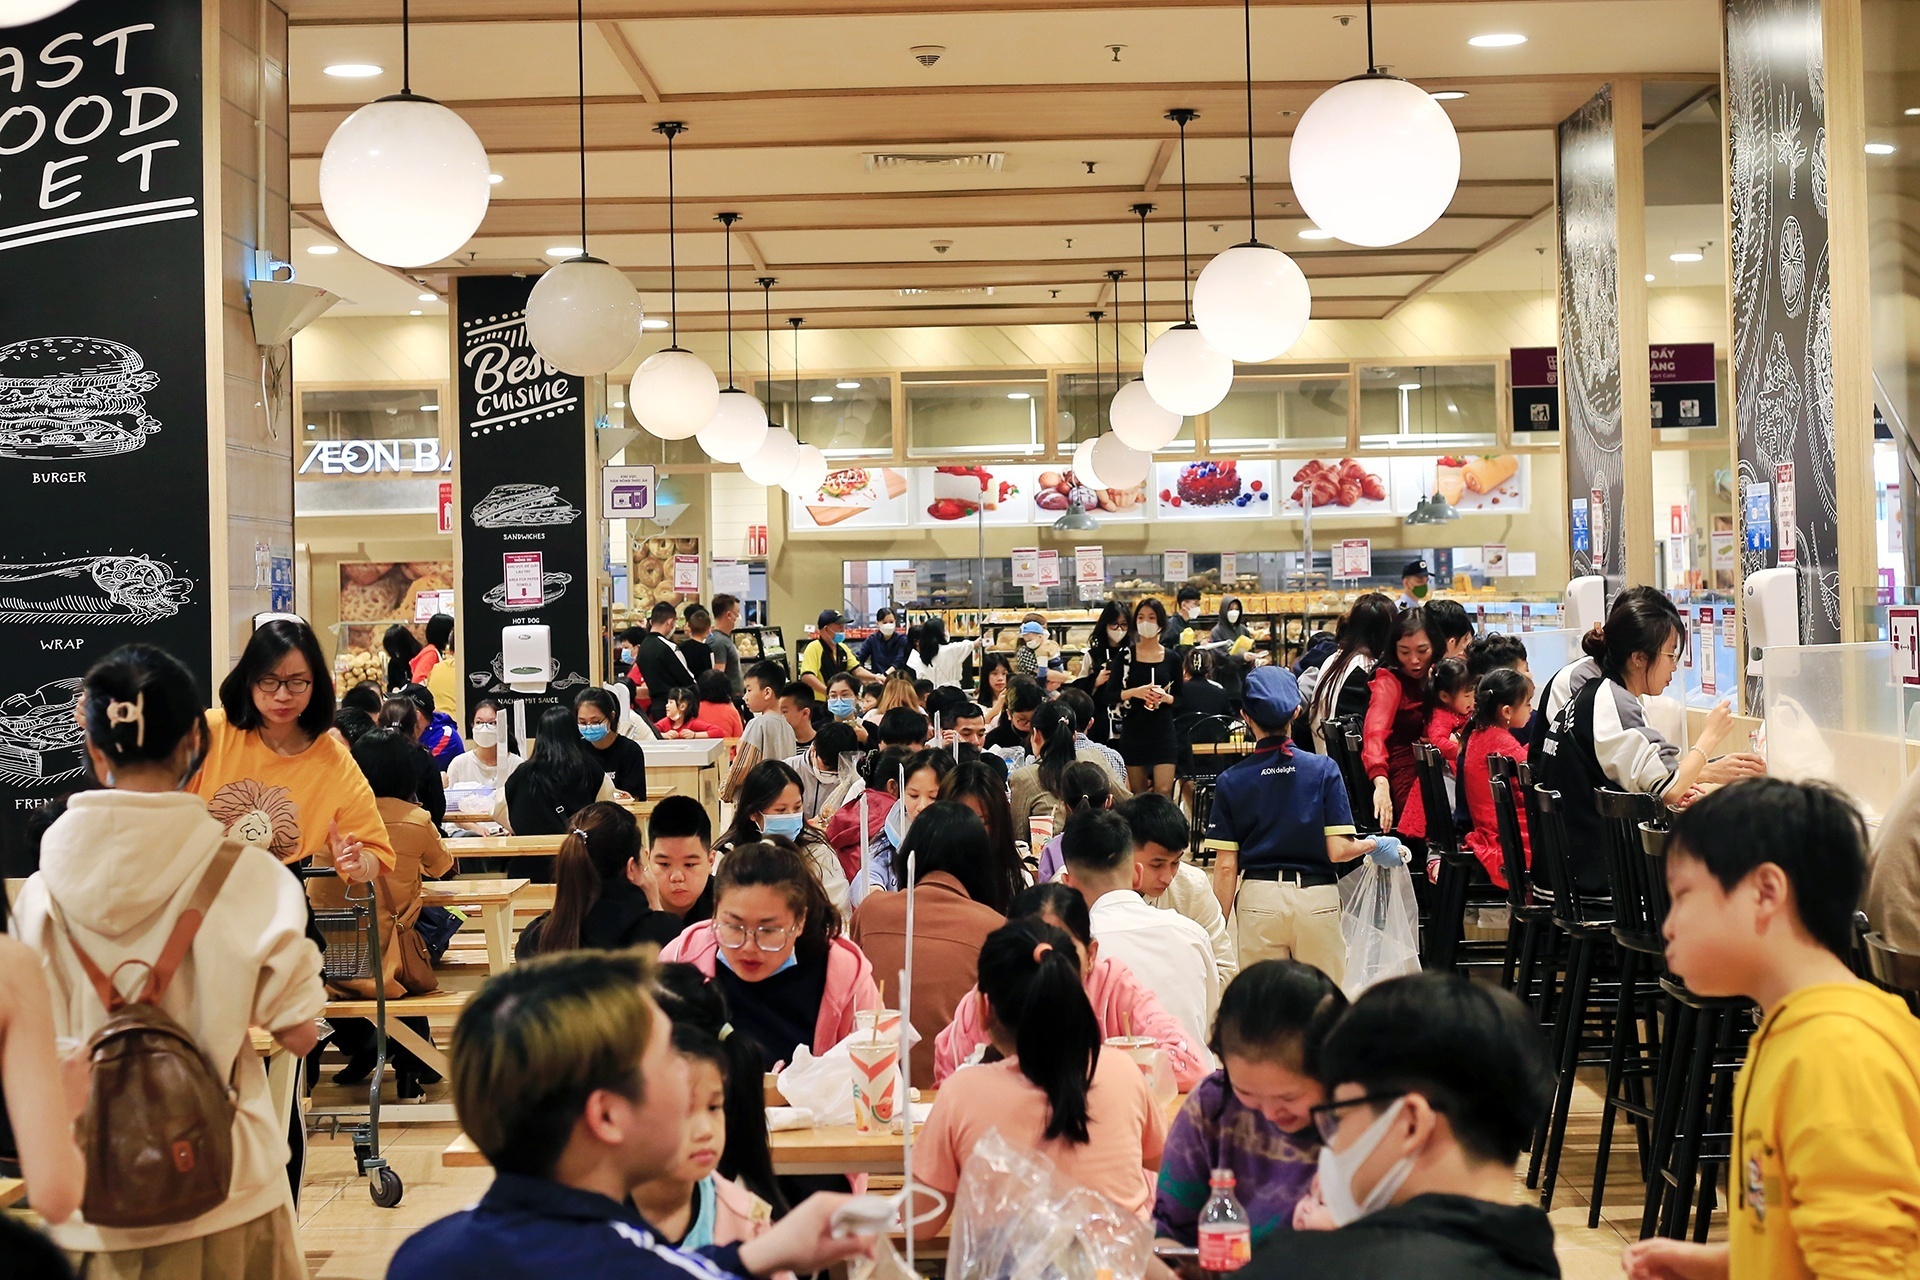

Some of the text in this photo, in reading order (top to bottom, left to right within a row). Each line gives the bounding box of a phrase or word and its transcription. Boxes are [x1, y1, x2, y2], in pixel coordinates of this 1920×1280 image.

[0, 140, 180, 209] ET
[32, 471, 87, 483] BURGER
[40, 639, 85, 650] WRAP
